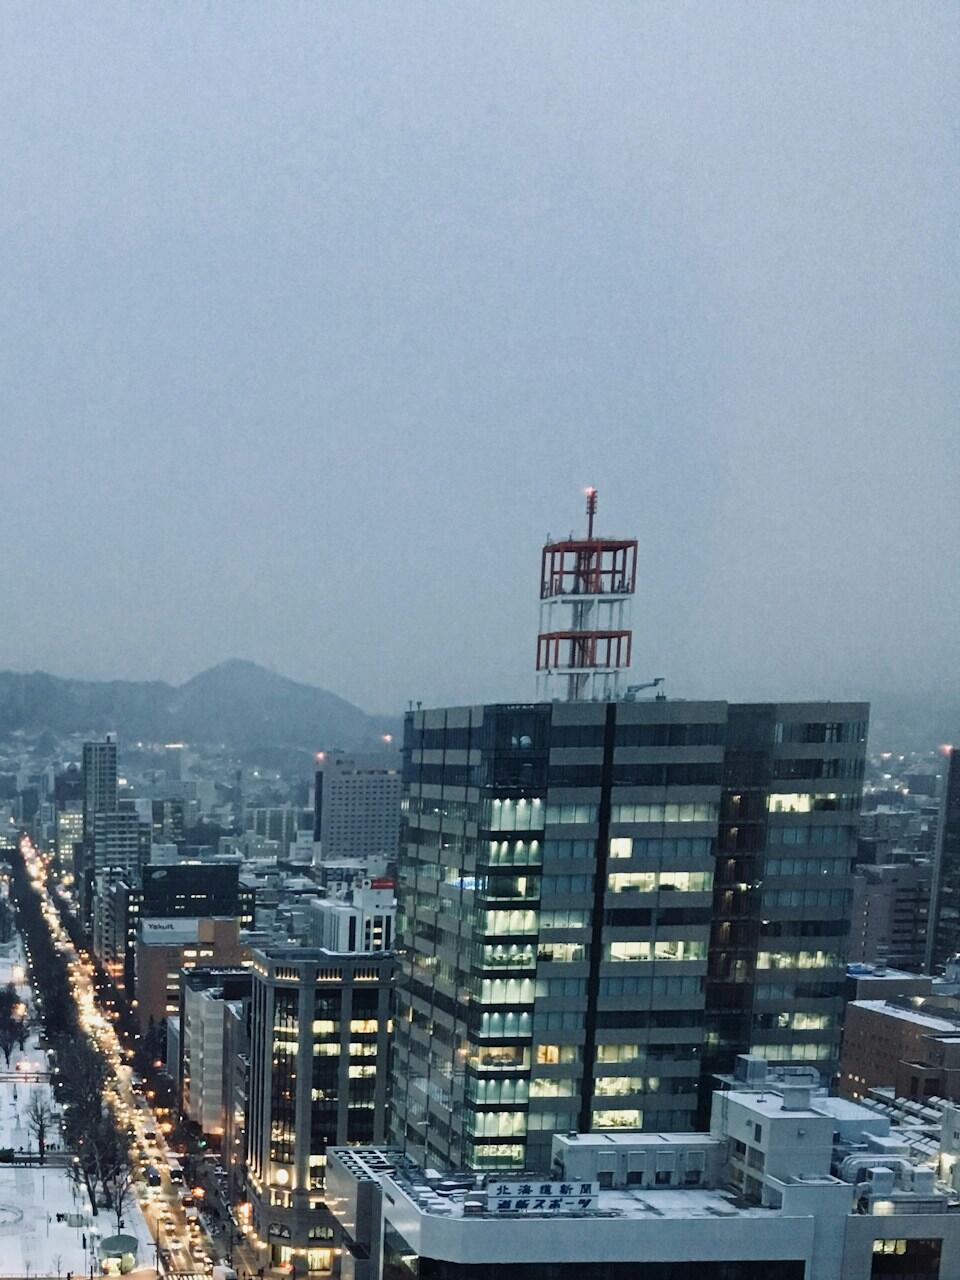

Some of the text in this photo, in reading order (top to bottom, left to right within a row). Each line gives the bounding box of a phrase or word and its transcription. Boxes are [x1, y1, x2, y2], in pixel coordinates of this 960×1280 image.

[496, 1183, 592, 1195] 北海道新聞
